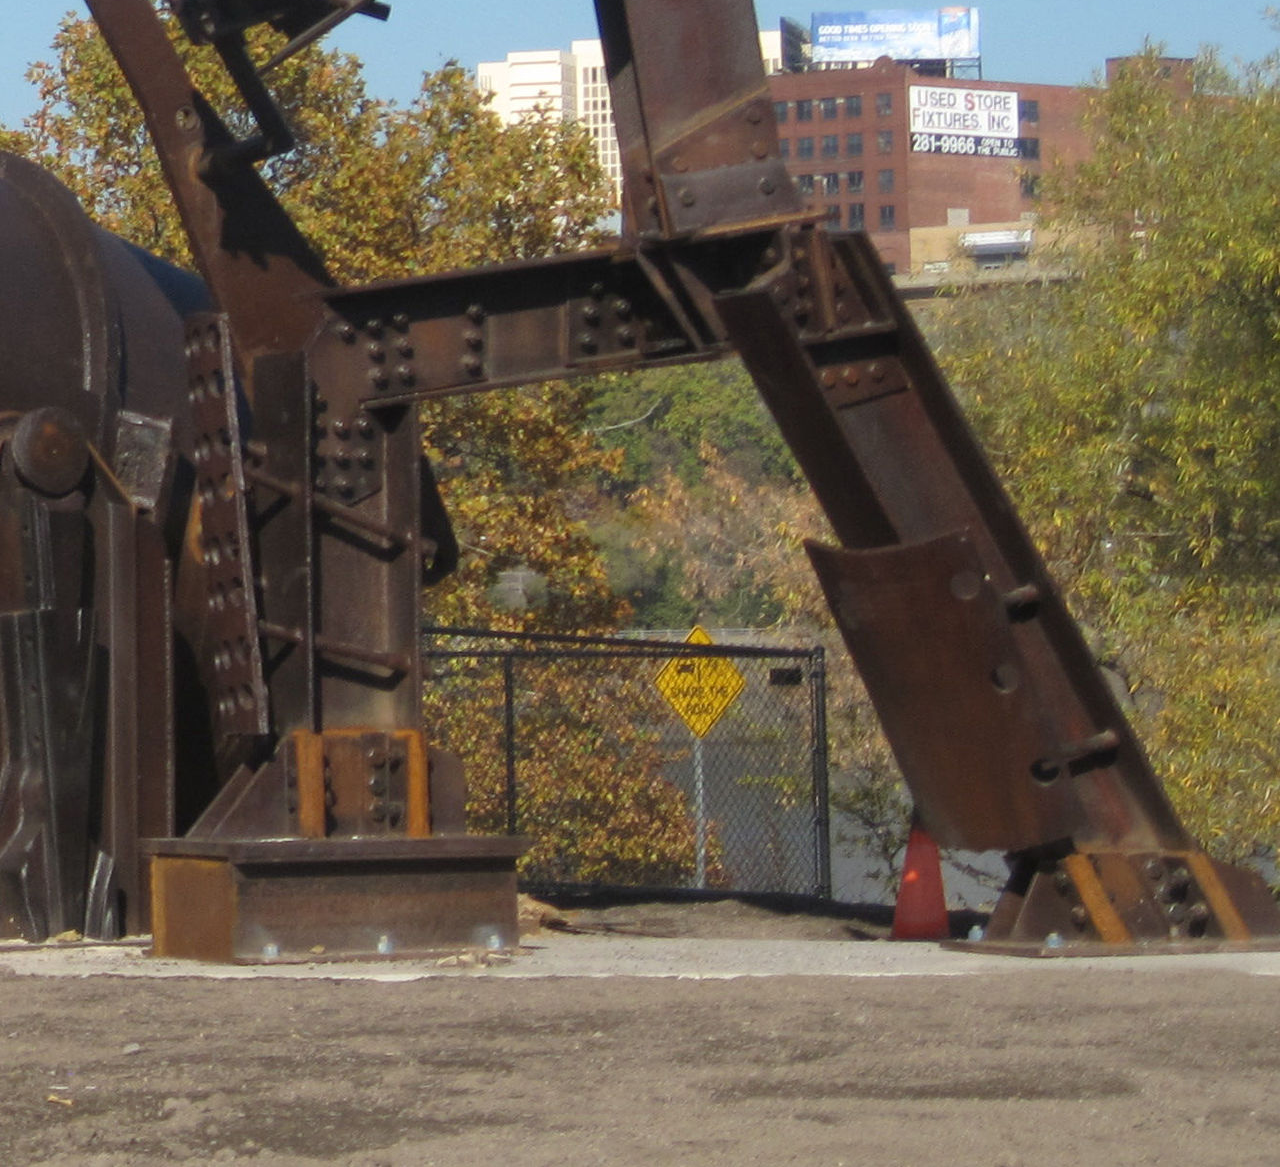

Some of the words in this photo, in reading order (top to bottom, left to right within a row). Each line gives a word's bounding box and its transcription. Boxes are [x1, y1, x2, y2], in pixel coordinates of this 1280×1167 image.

[917, 90, 957, 109] USED
[964, 92, 1012, 112] STORE
[1003, 139, 1014, 149] TO
[709, 685, 729, 698] THE
